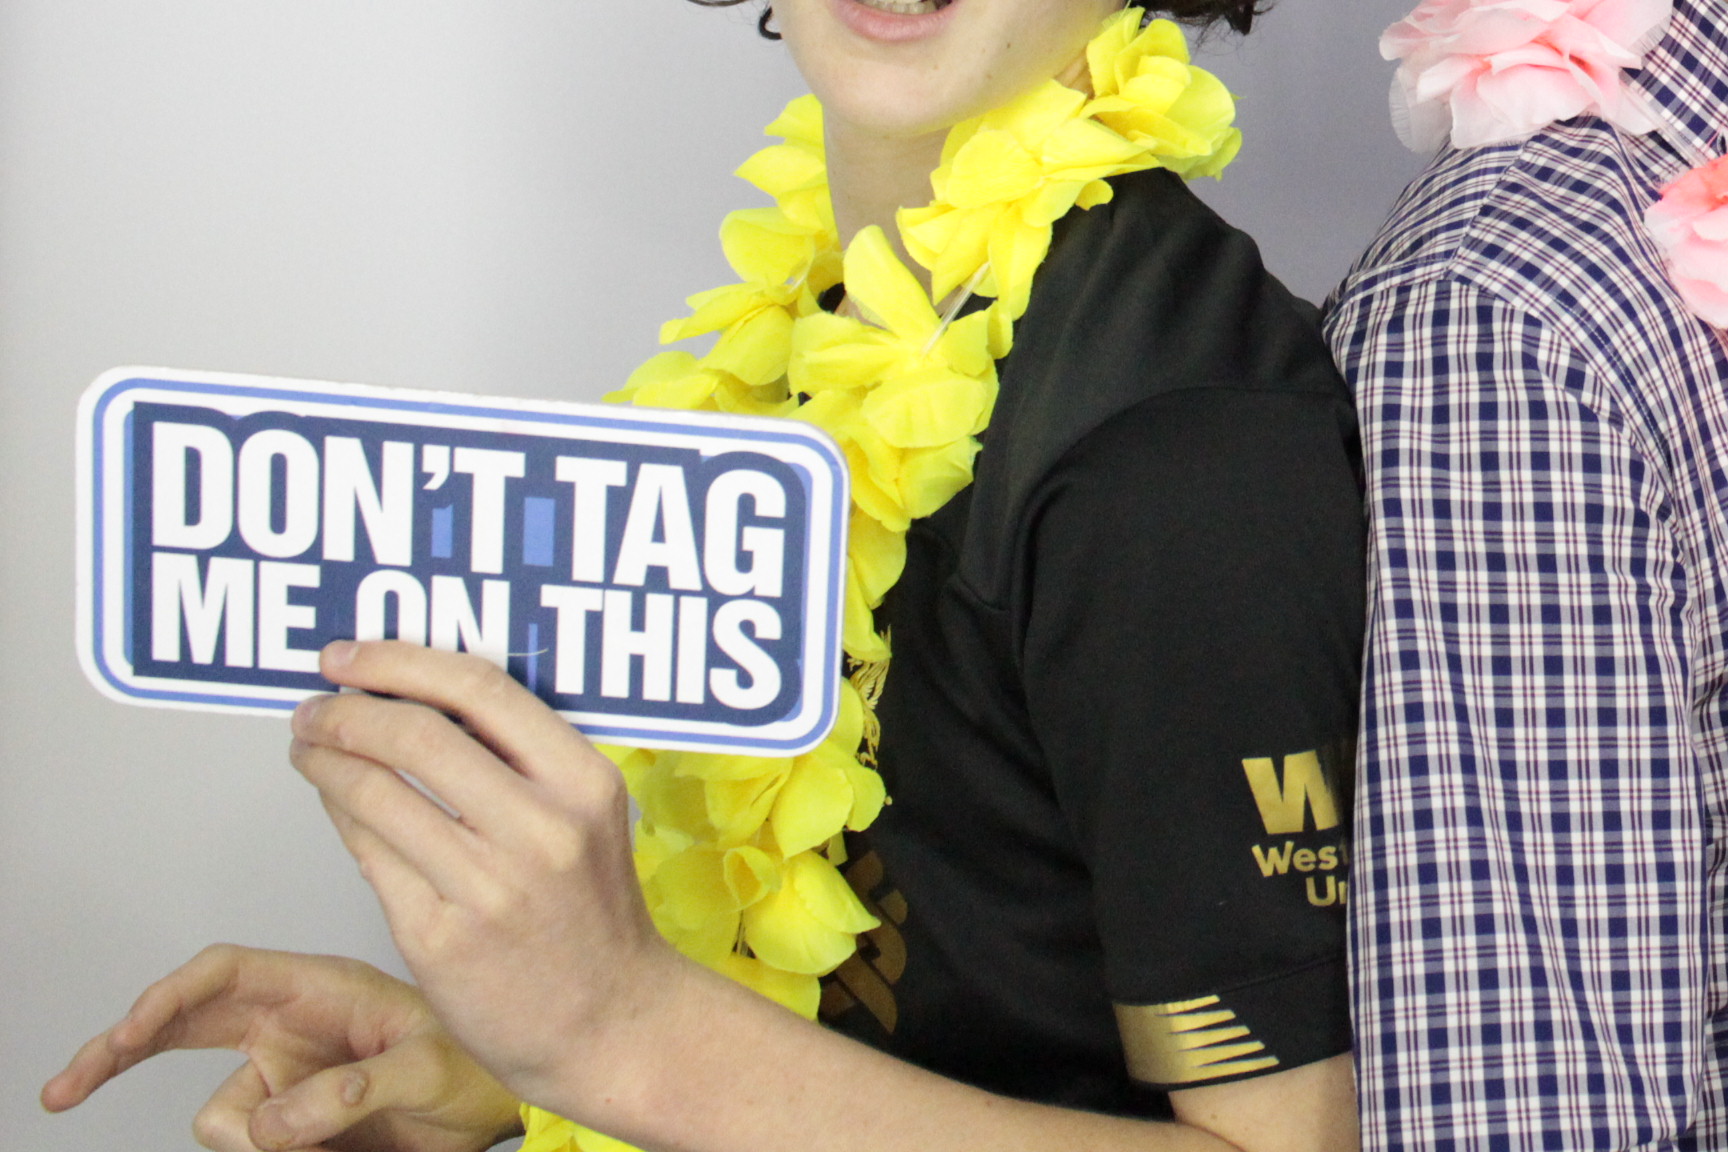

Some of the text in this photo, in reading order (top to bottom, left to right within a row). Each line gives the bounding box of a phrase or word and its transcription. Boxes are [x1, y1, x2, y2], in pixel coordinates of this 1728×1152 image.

[151, 420, 787, 598] DON'T TAG
[151, 552, 783, 710] ME ON THIS
